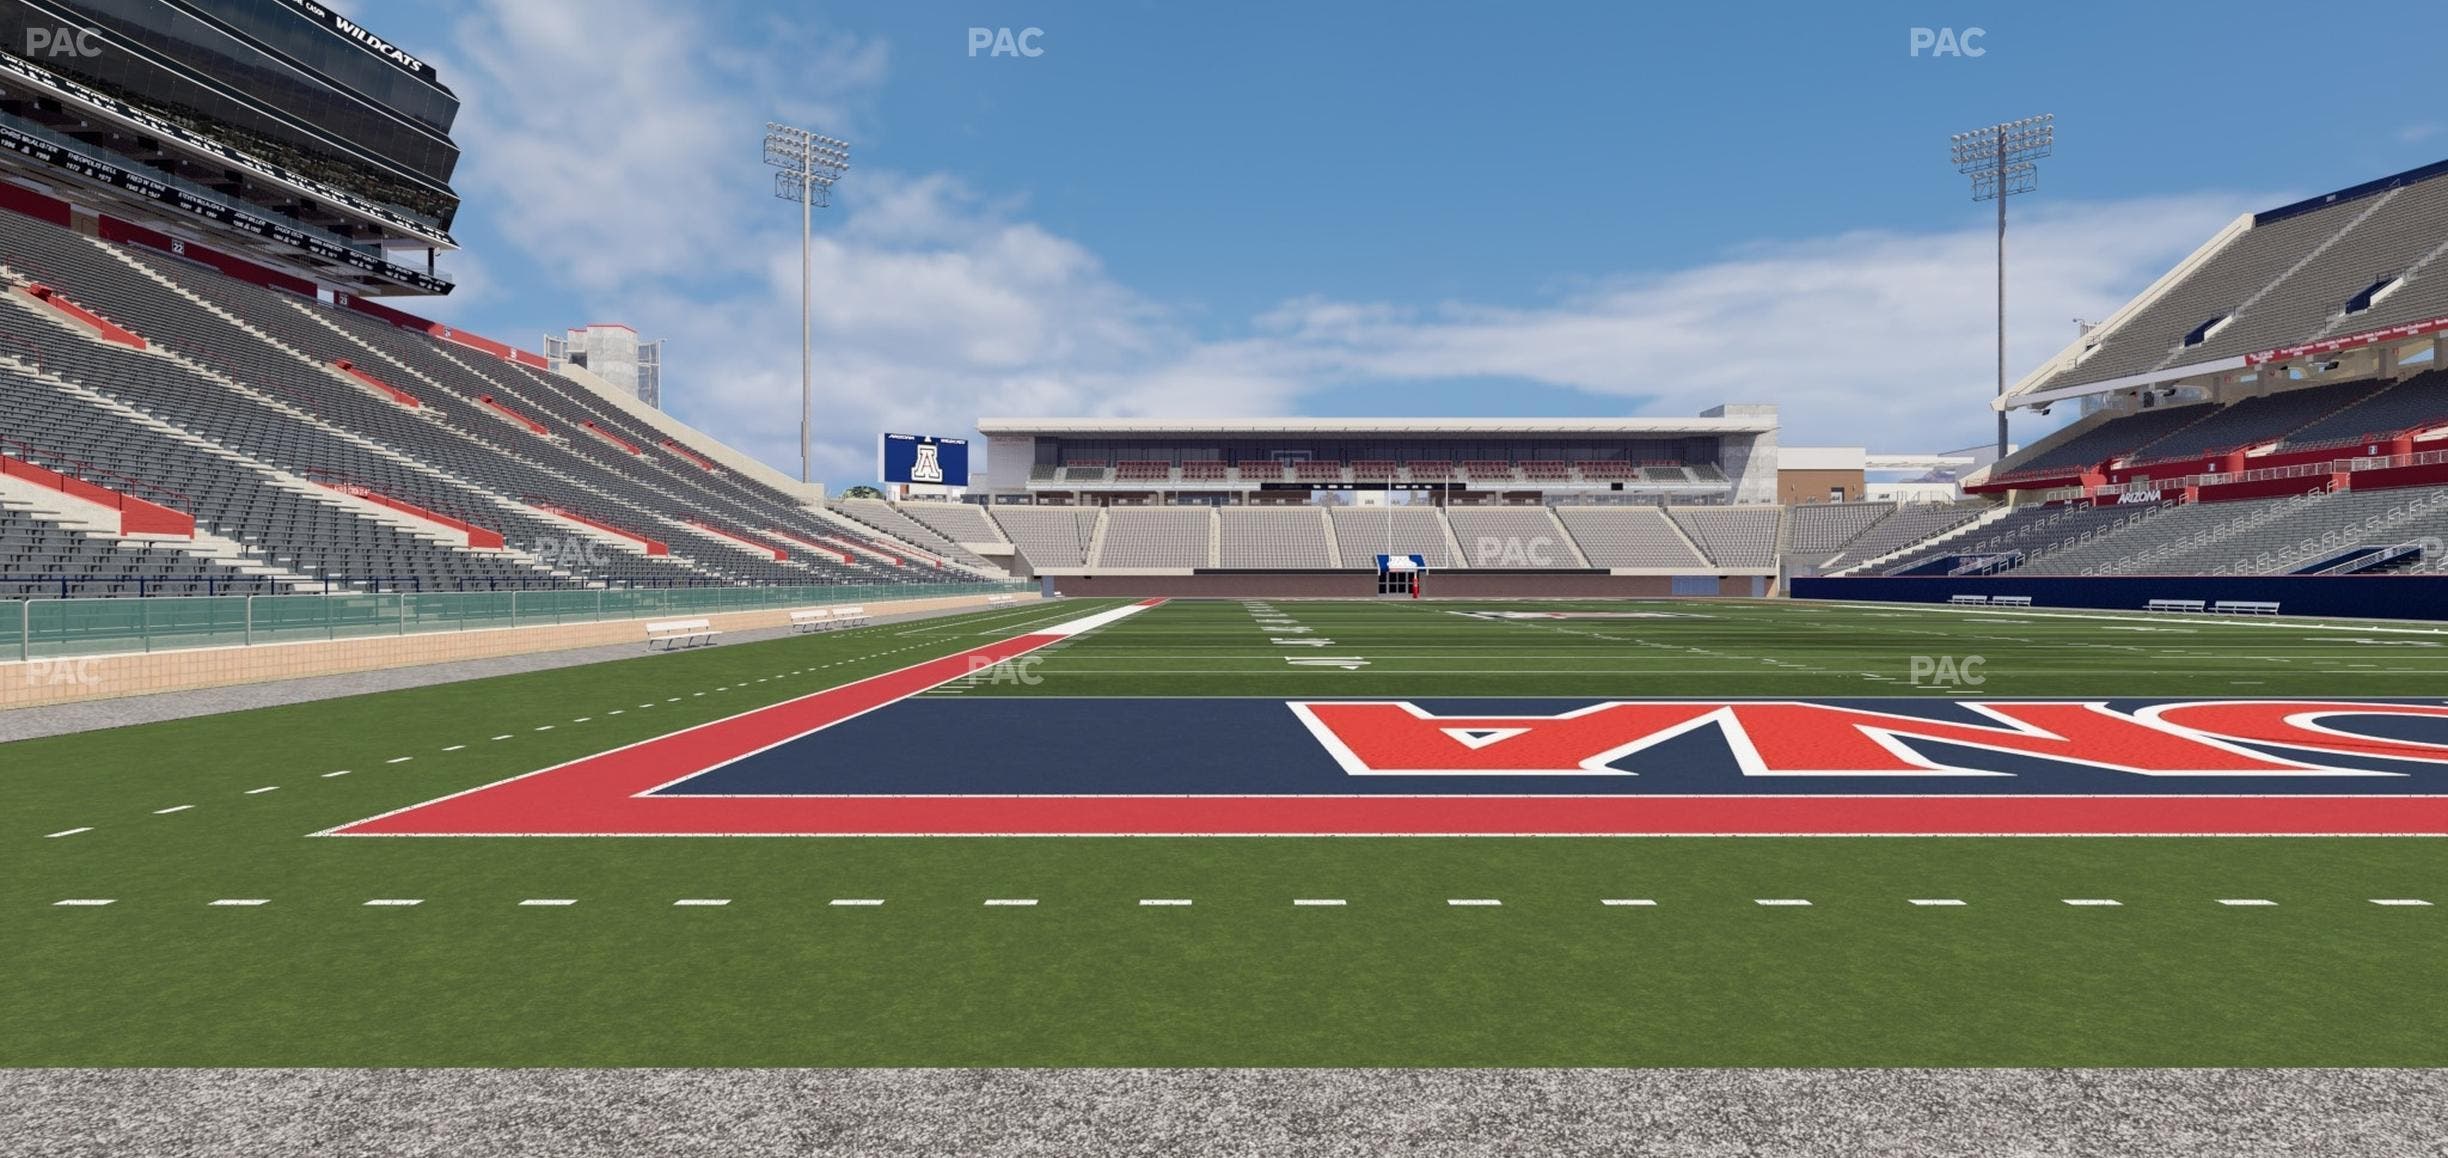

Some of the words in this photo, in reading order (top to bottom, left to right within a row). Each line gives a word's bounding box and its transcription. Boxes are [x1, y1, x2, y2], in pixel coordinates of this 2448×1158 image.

[336, 16, 423, 72] WILDCATS
[911, 444, 943, 483] A
[2116, 489, 2161, 505] ARIZONA
